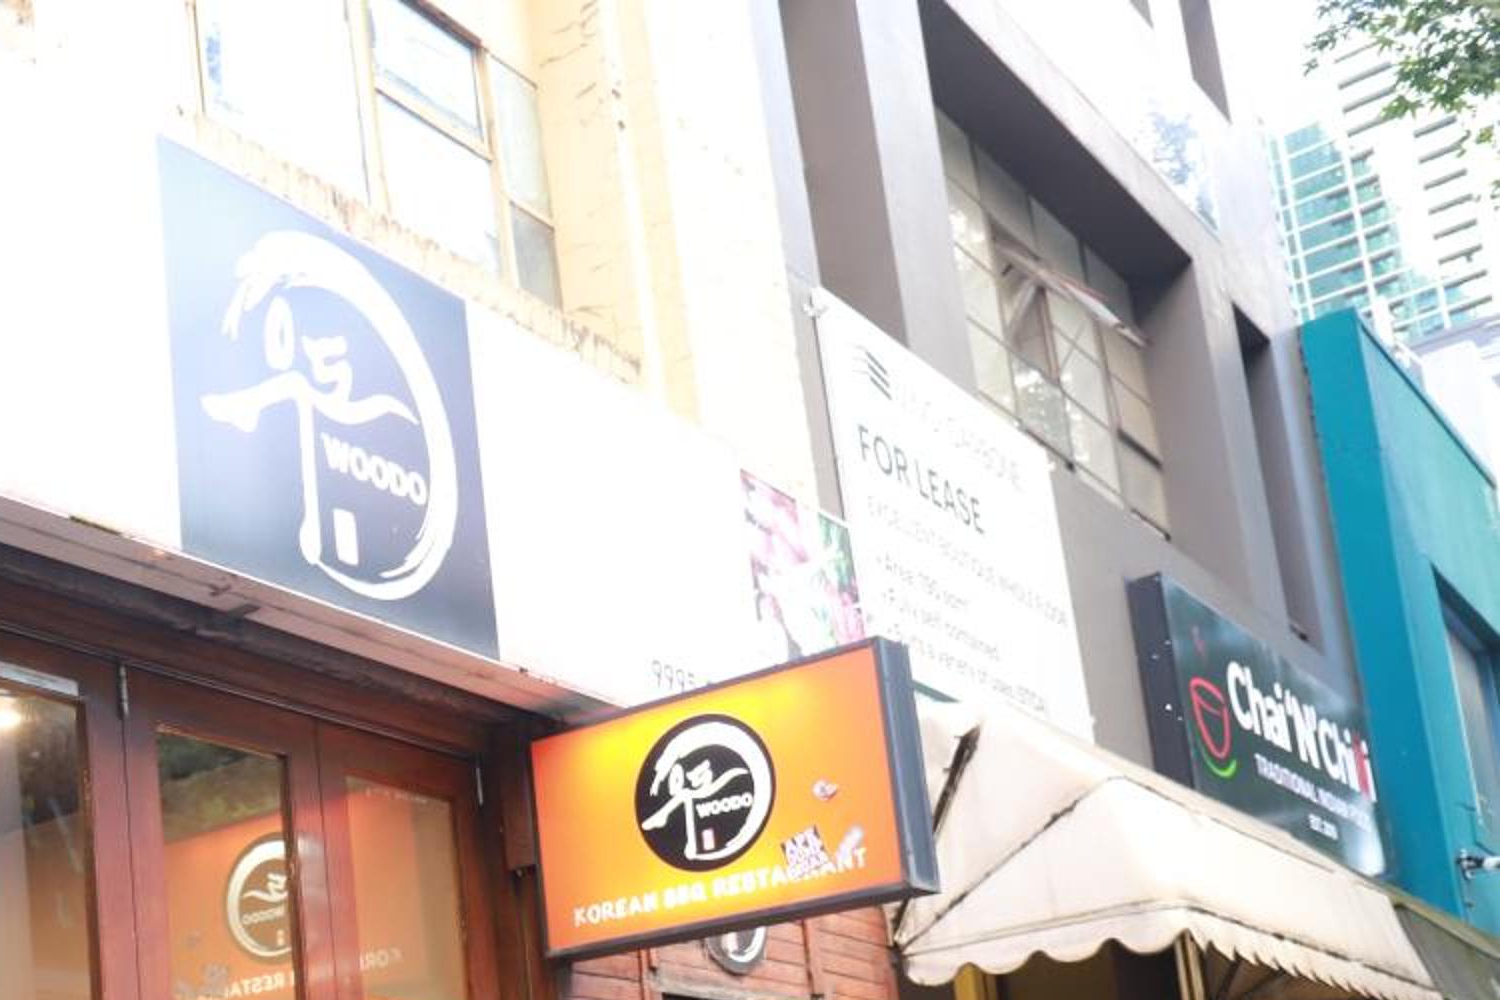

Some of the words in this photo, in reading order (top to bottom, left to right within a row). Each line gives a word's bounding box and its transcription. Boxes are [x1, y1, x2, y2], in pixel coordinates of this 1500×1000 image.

[321, 432, 428, 506] WOODO
[857, 423, 911, 488] FOR
[914, 457, 986, 535] LEASE
[696, 791, 754, 819] WOODO
[574, 890, 660, 927] KOREAN
[663, 882, 708, 907] BBQ
